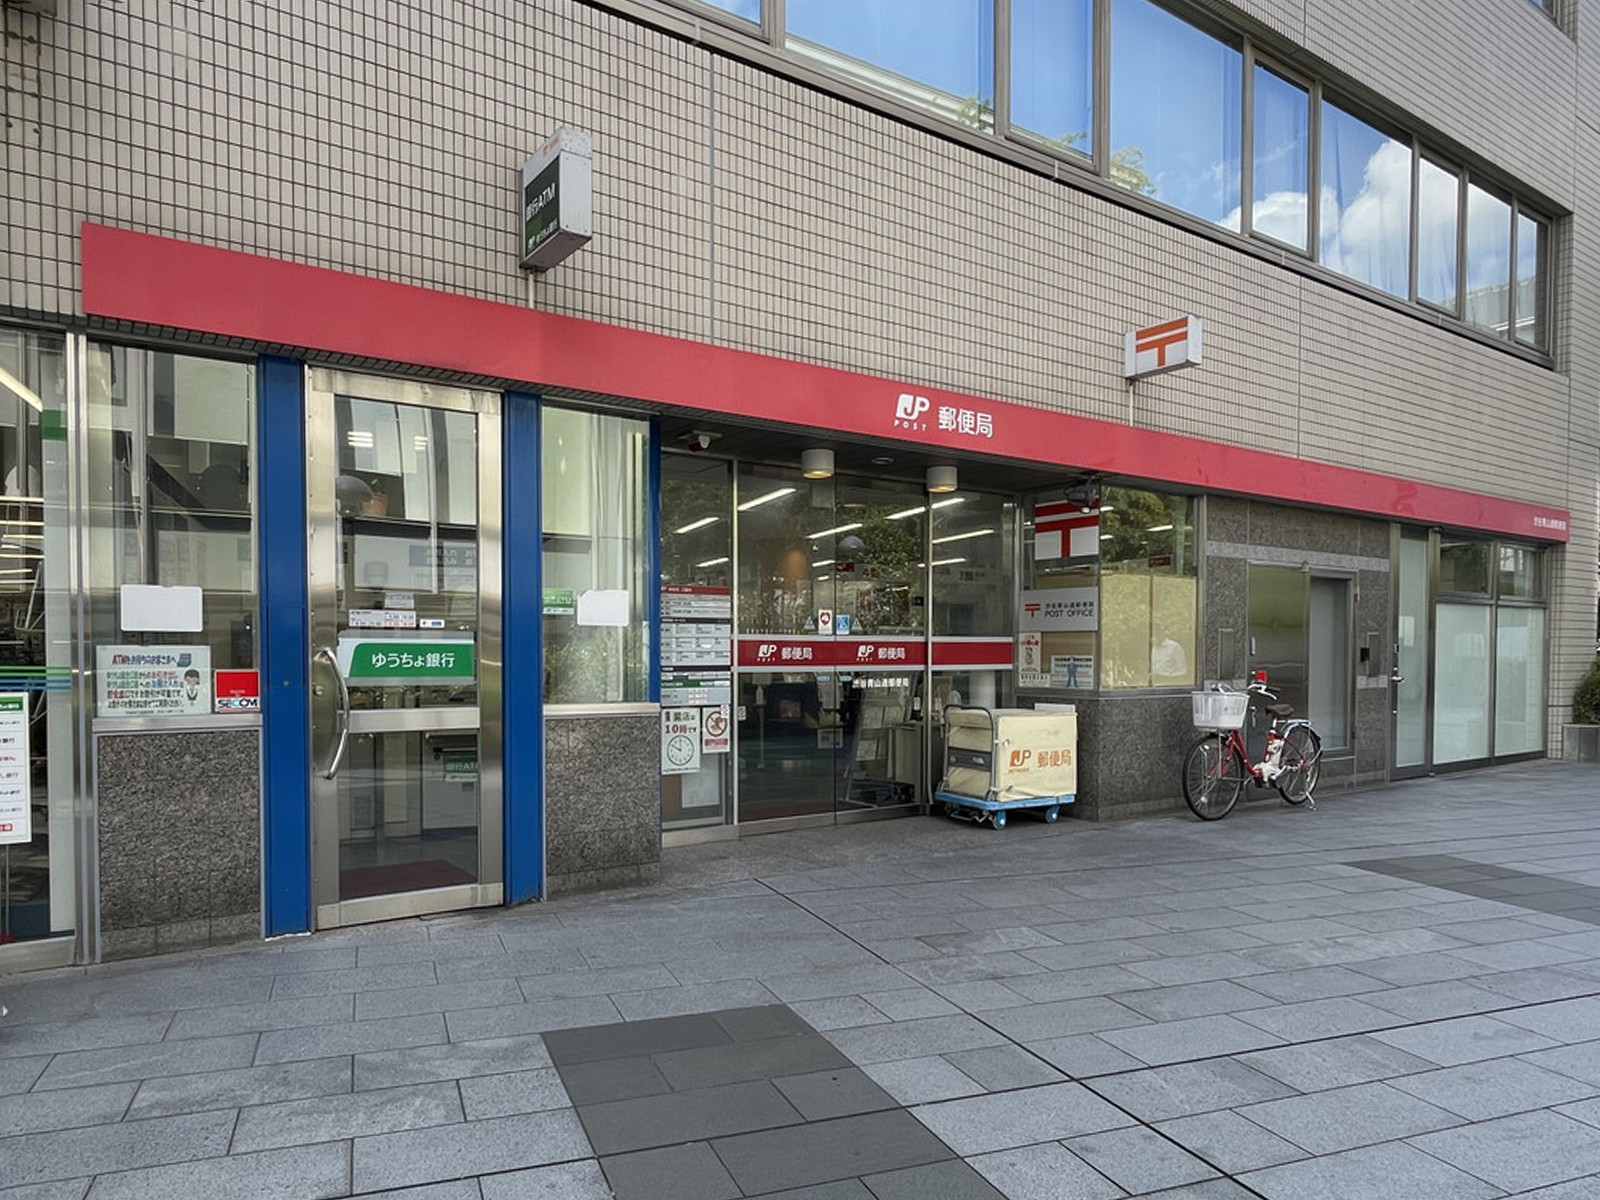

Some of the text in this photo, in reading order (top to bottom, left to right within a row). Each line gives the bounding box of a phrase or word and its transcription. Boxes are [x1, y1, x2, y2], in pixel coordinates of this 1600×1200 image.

[893, 419, 927, 431] POST
[938, 406, 993, 438] 郵便局
[1044, 608, 1094, 618] POST OFFICE
[371, 652, 456, 668] ゆうちょ銀行
[781, 647, 813, 660] 郵便局
[877, 647, 906, 660] 郵便局
[217, 698, 258, 708] SECOM
[1037, 749, 1071, 768] 郵便局
